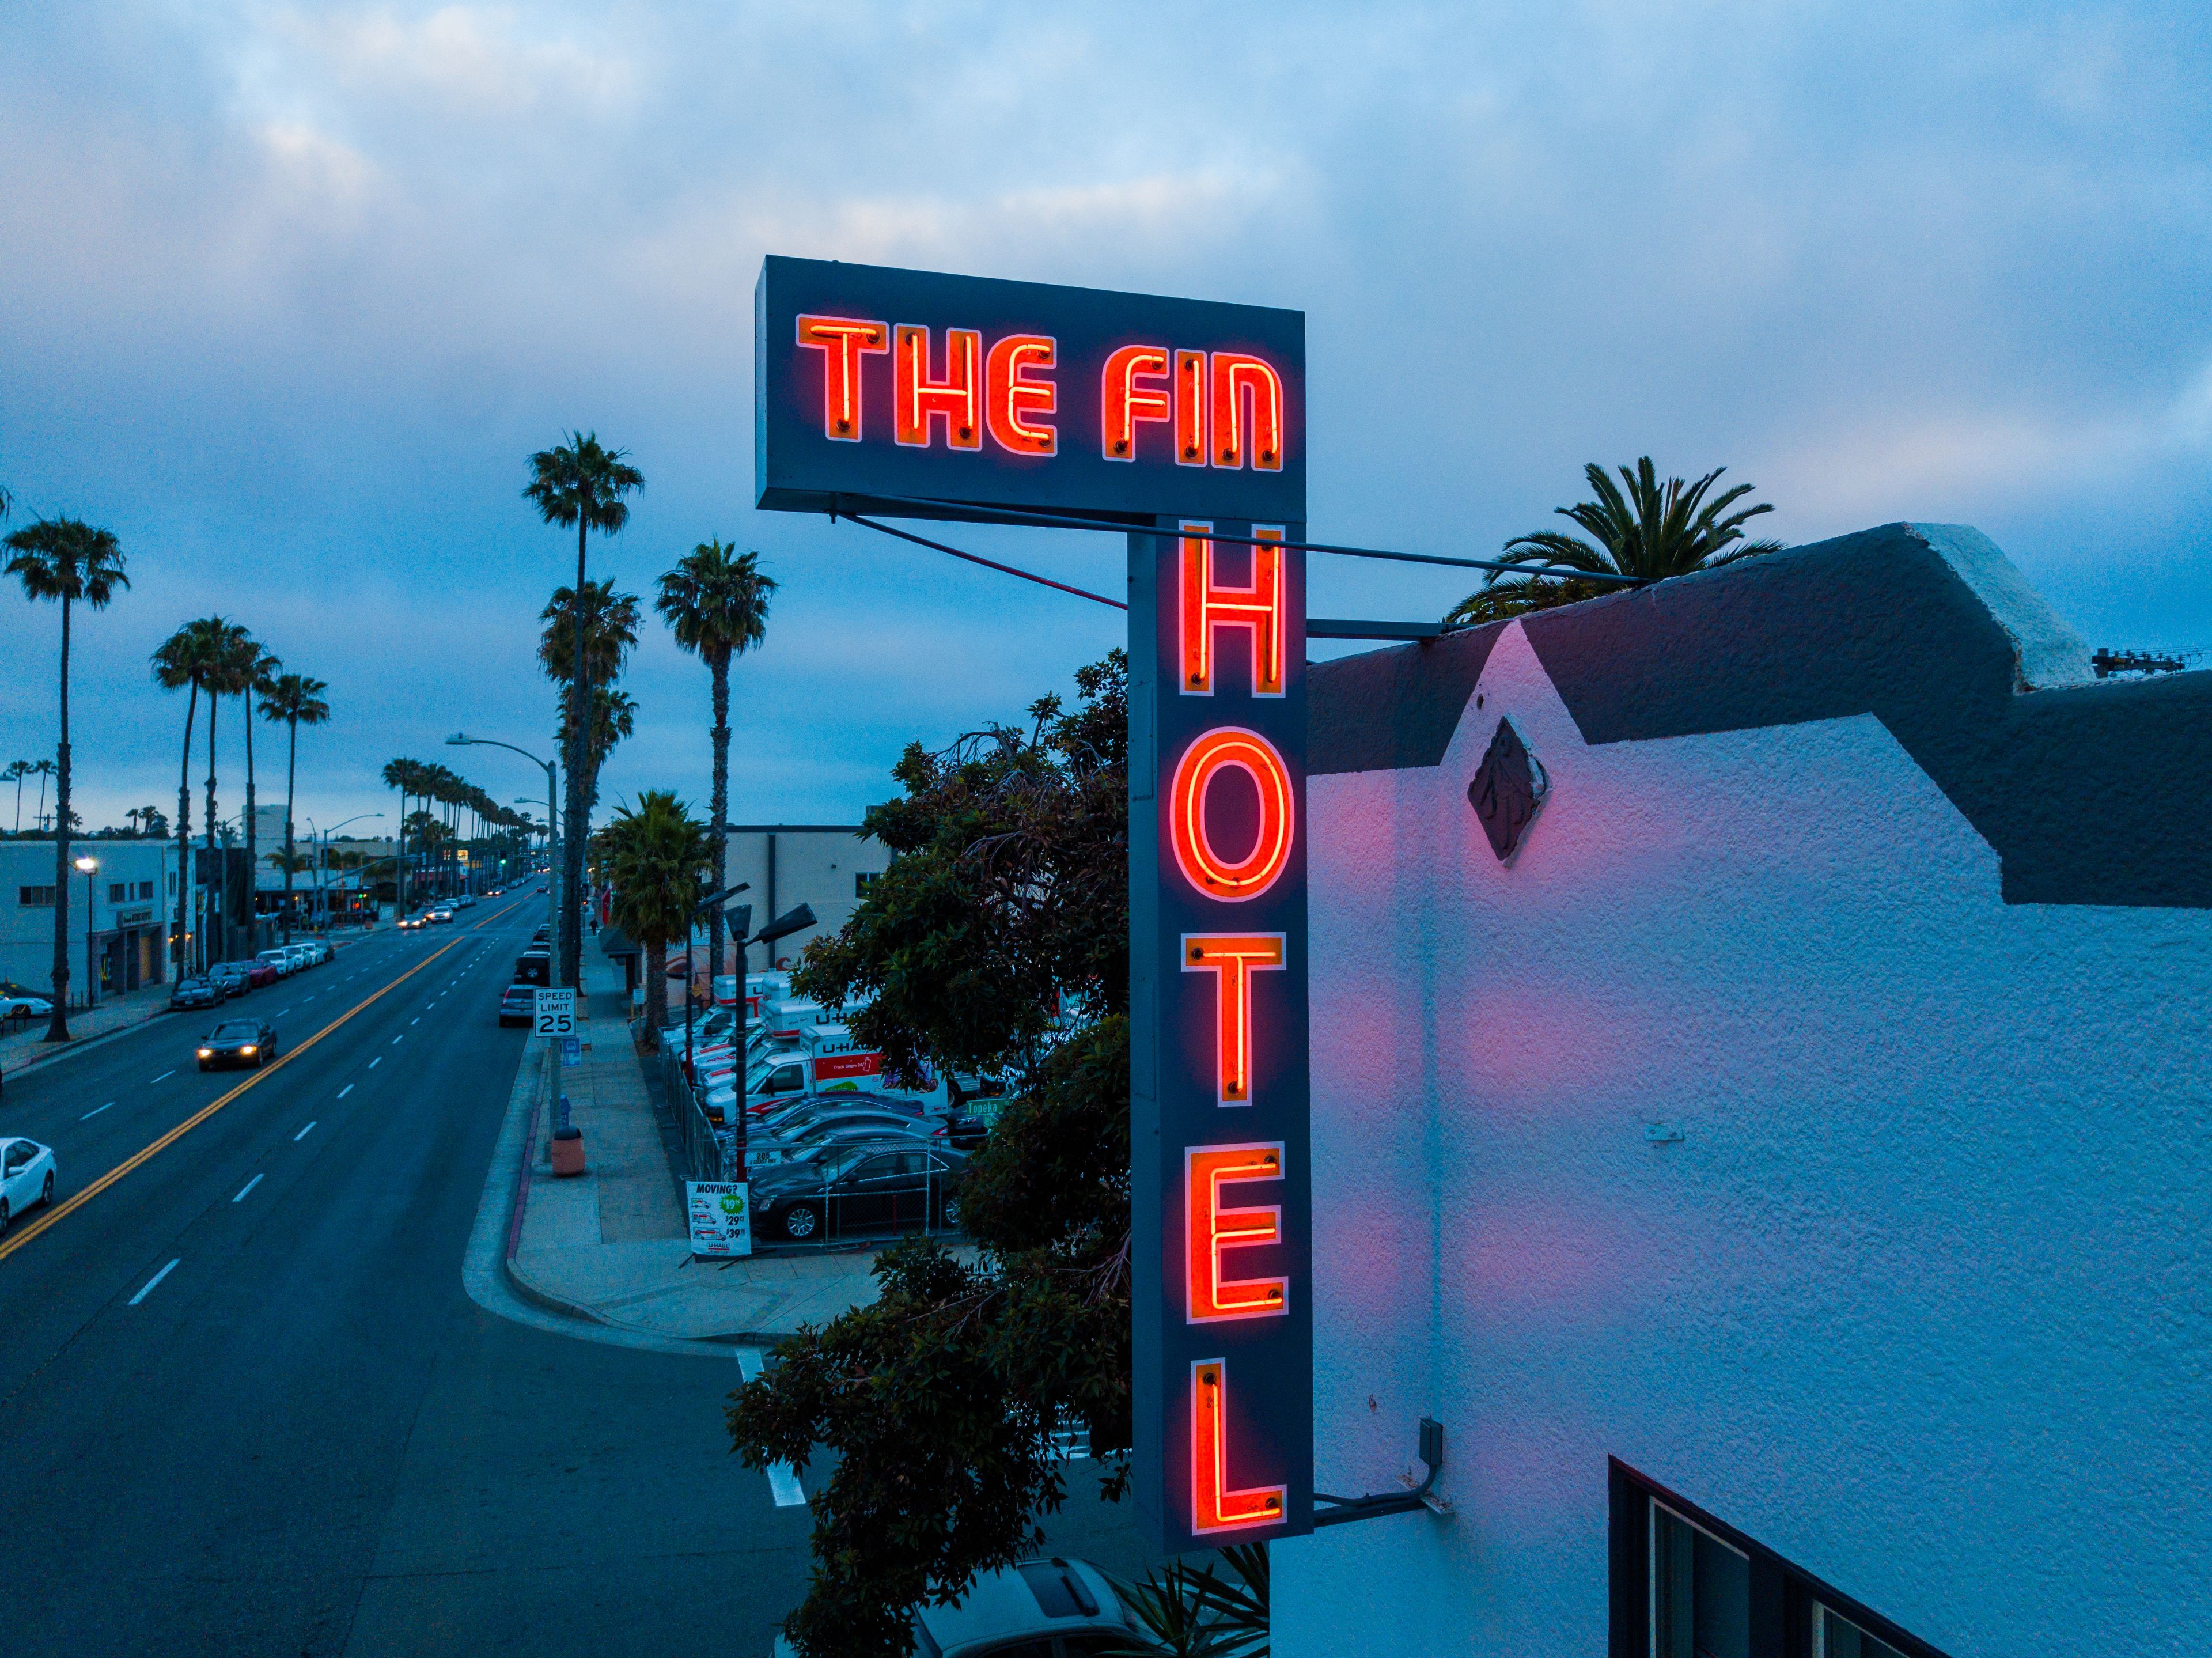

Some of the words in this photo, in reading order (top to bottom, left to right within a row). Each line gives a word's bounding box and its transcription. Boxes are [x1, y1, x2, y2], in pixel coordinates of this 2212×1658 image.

[795, 313, 1058, 457] THE
[1102, 345, 1284, 473] FIN
[538, 992, 572, 1001] SPEED
[541, 1004, 569, 1012] LIMIT
[540, 1015, 571, 1033] 25
[1169, 520, 1294, 1536] HOTEL
[968, 1101, 997, 1115] Topeka
[696, 1184, 737, 1194] MOVING?
